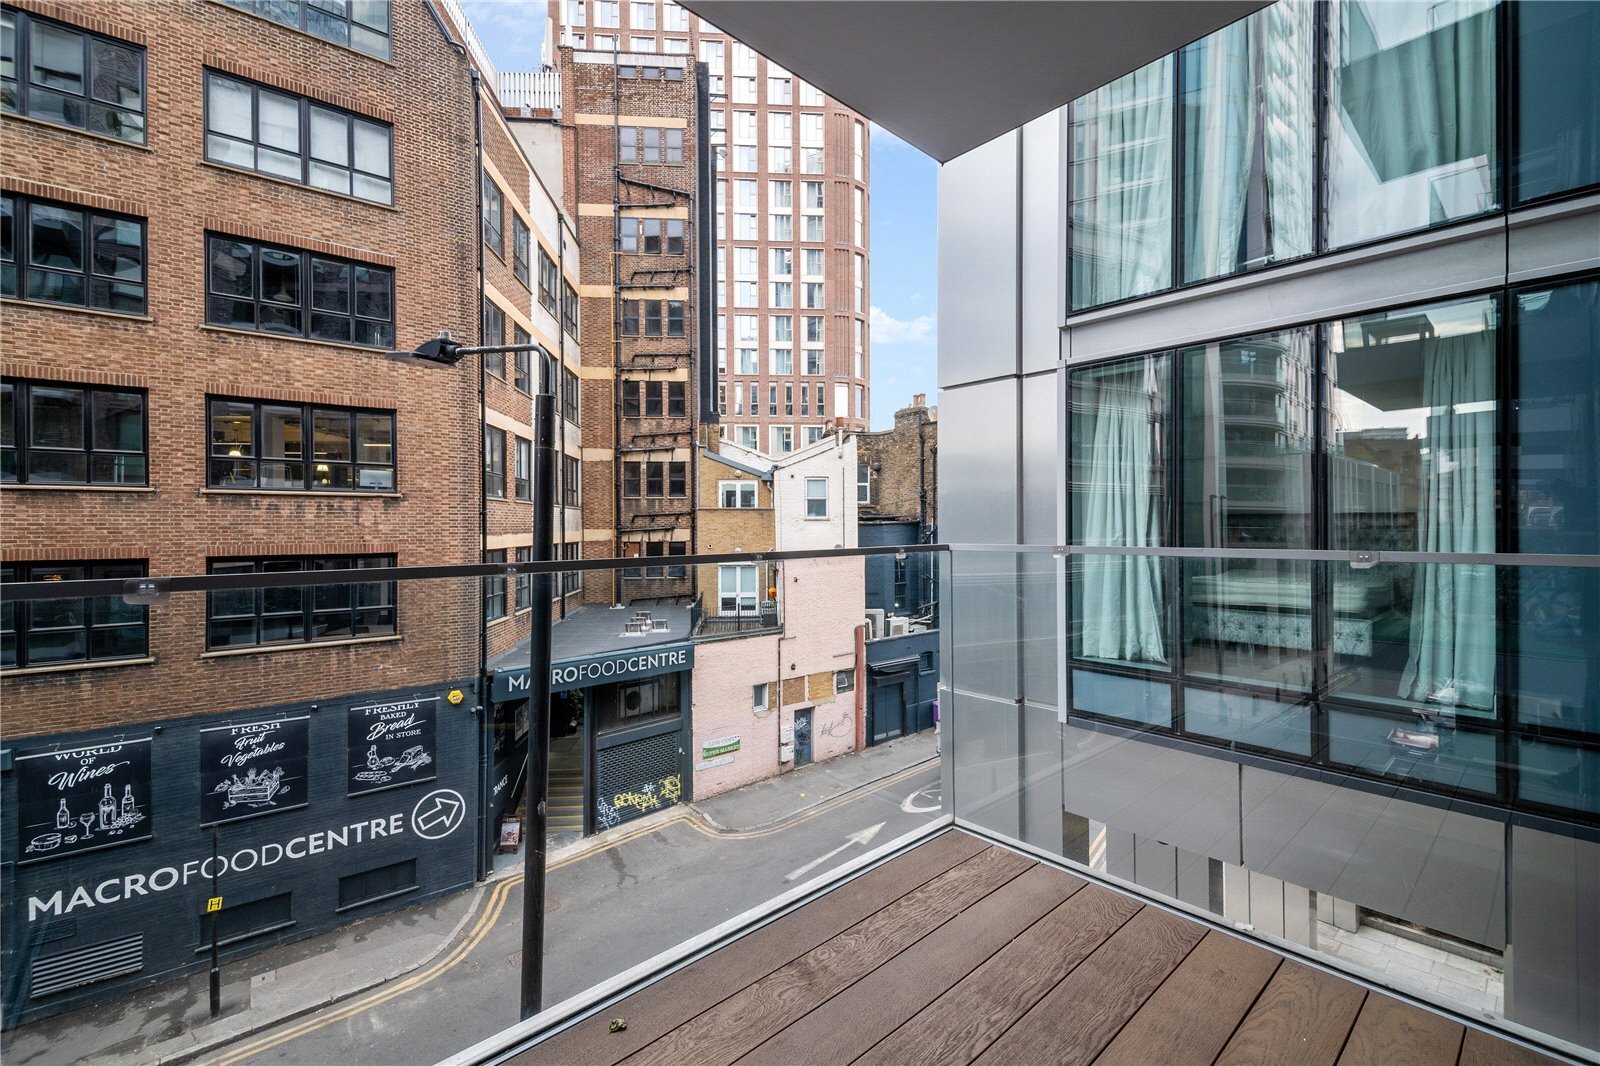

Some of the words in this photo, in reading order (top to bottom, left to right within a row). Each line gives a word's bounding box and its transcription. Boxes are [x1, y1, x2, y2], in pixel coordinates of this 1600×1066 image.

[508, 650, 686, 692] MROFOODCENTRE
[366, 713, 427, 741] Bread
[380, 711, 407, 721] BAKED
[230, 722, 282, 736] FRESH
[234, 730, 276, 750] Fruit
[396, 729, 422, 739] STORE
[80, 757, 97, 766] OF
[220, 742, 286, 768] Vegetables
[48, 761, 130, 791] Wines
[28, 813, 404, 922] MACROFOODCENTRE
